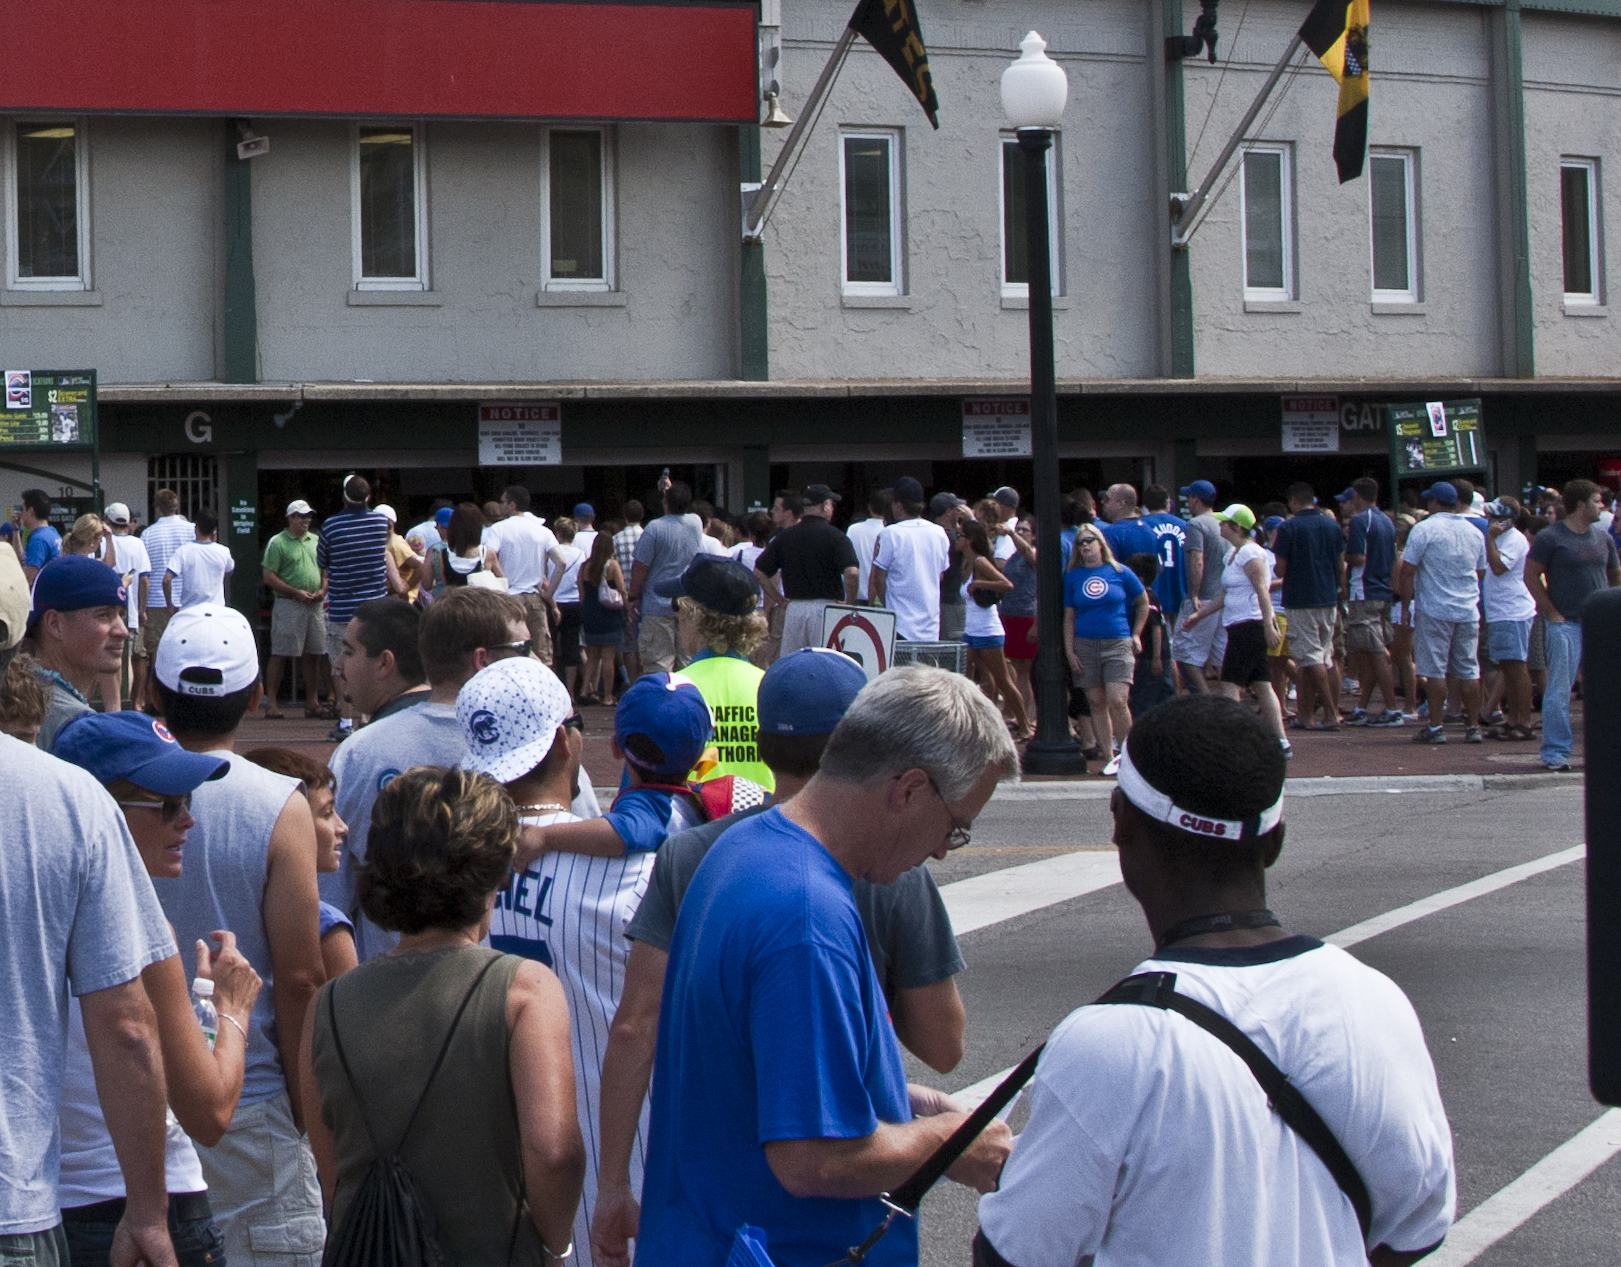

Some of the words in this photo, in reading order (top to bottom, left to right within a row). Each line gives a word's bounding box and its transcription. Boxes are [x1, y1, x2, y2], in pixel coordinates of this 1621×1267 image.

[48, 390, 58, 403] $2
[972, 402, 1022, 414] NOTICE
[1289, 400, 1332, 411] NOTICE
[490, 407, 550, 420] NOTICE
[1341, 402, 1388, 431] GAT
[184, 411, 213, 443] G
[59, 486, 73, 498] 10
[188, 686, 214, 694] CUBS
[1180, 813, 1226, 836] CUBS
